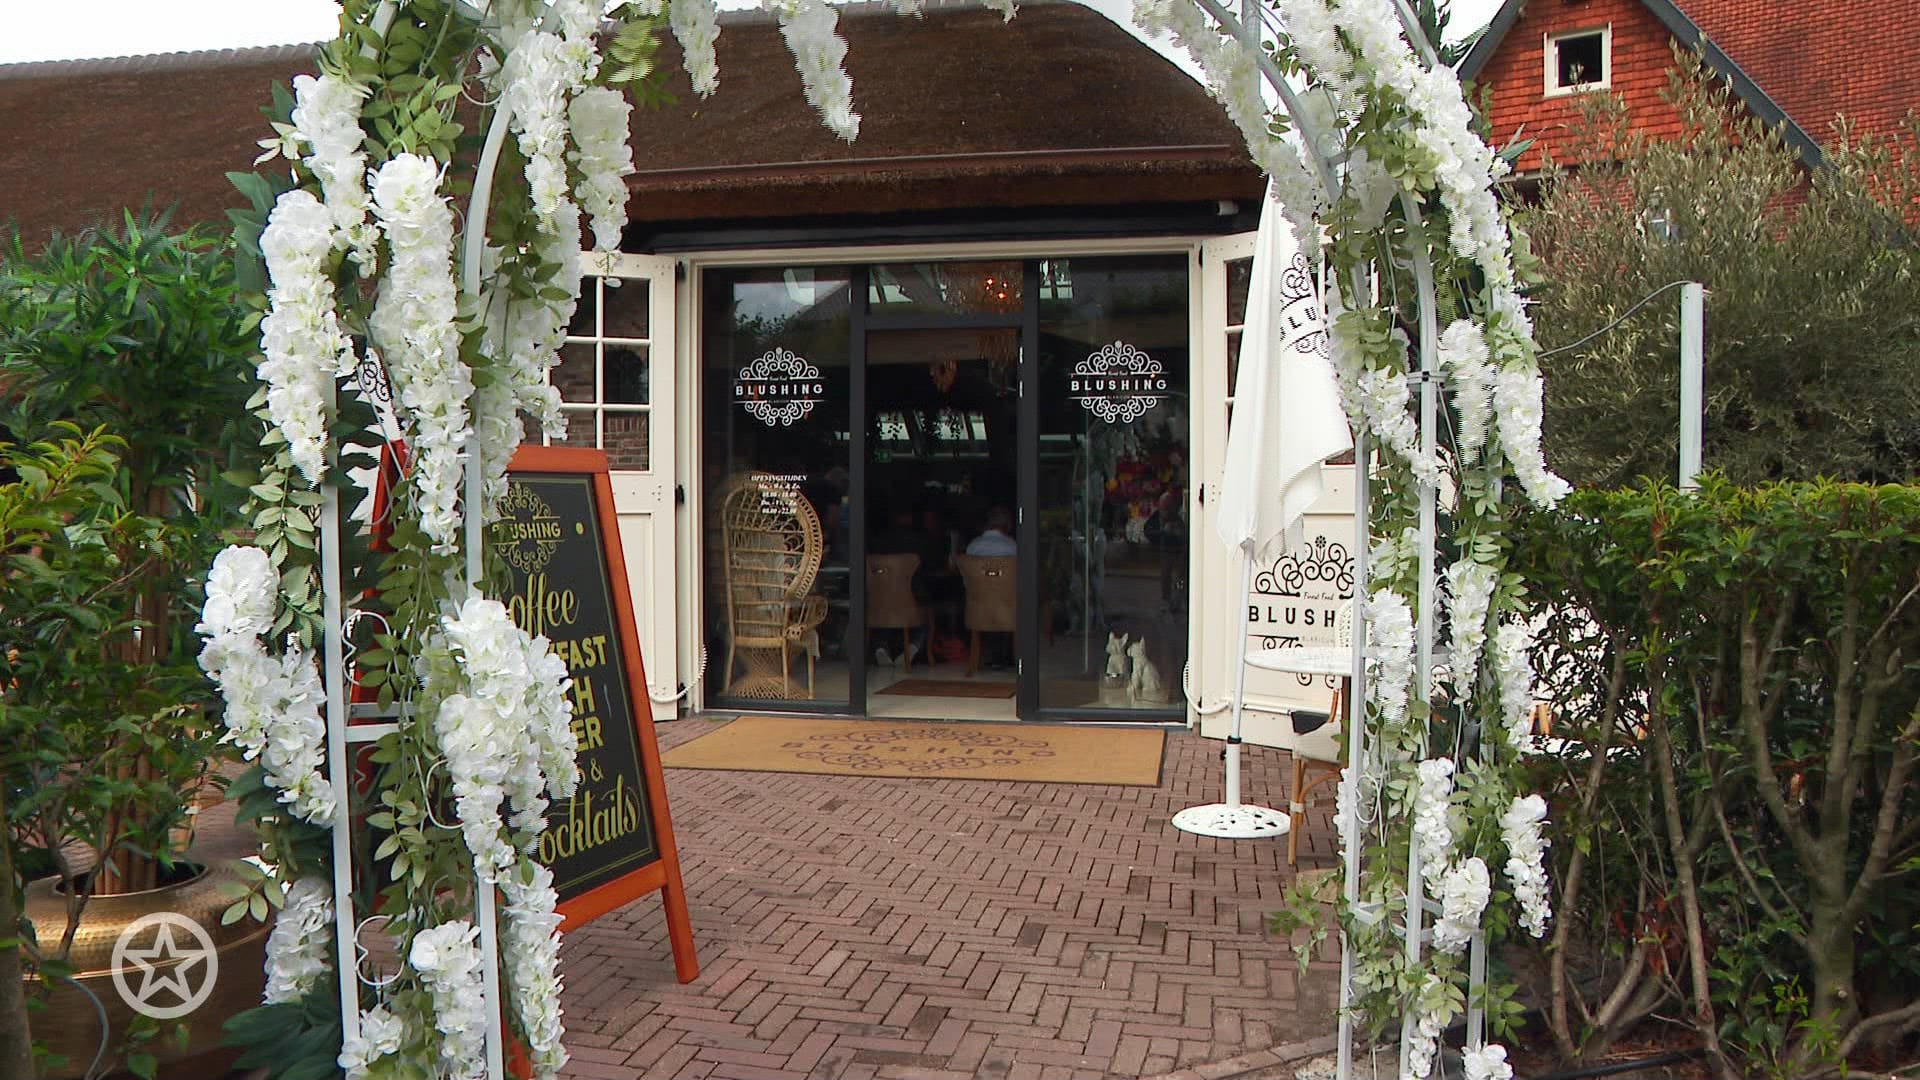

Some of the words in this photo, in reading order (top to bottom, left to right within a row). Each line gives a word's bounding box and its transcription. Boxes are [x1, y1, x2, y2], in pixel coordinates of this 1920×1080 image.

[735, 384, 823, 396] BLUSHING
[1071, 379, 1167, 391] BLUSHING
[492, 522, 561, 539] USHING
[506, 573, 581, 640] offee
[1248, 605, 1335, 628] BLUSH
[570, 716, 604, 752] ER
[538, 773, 641, 865] ocktails
